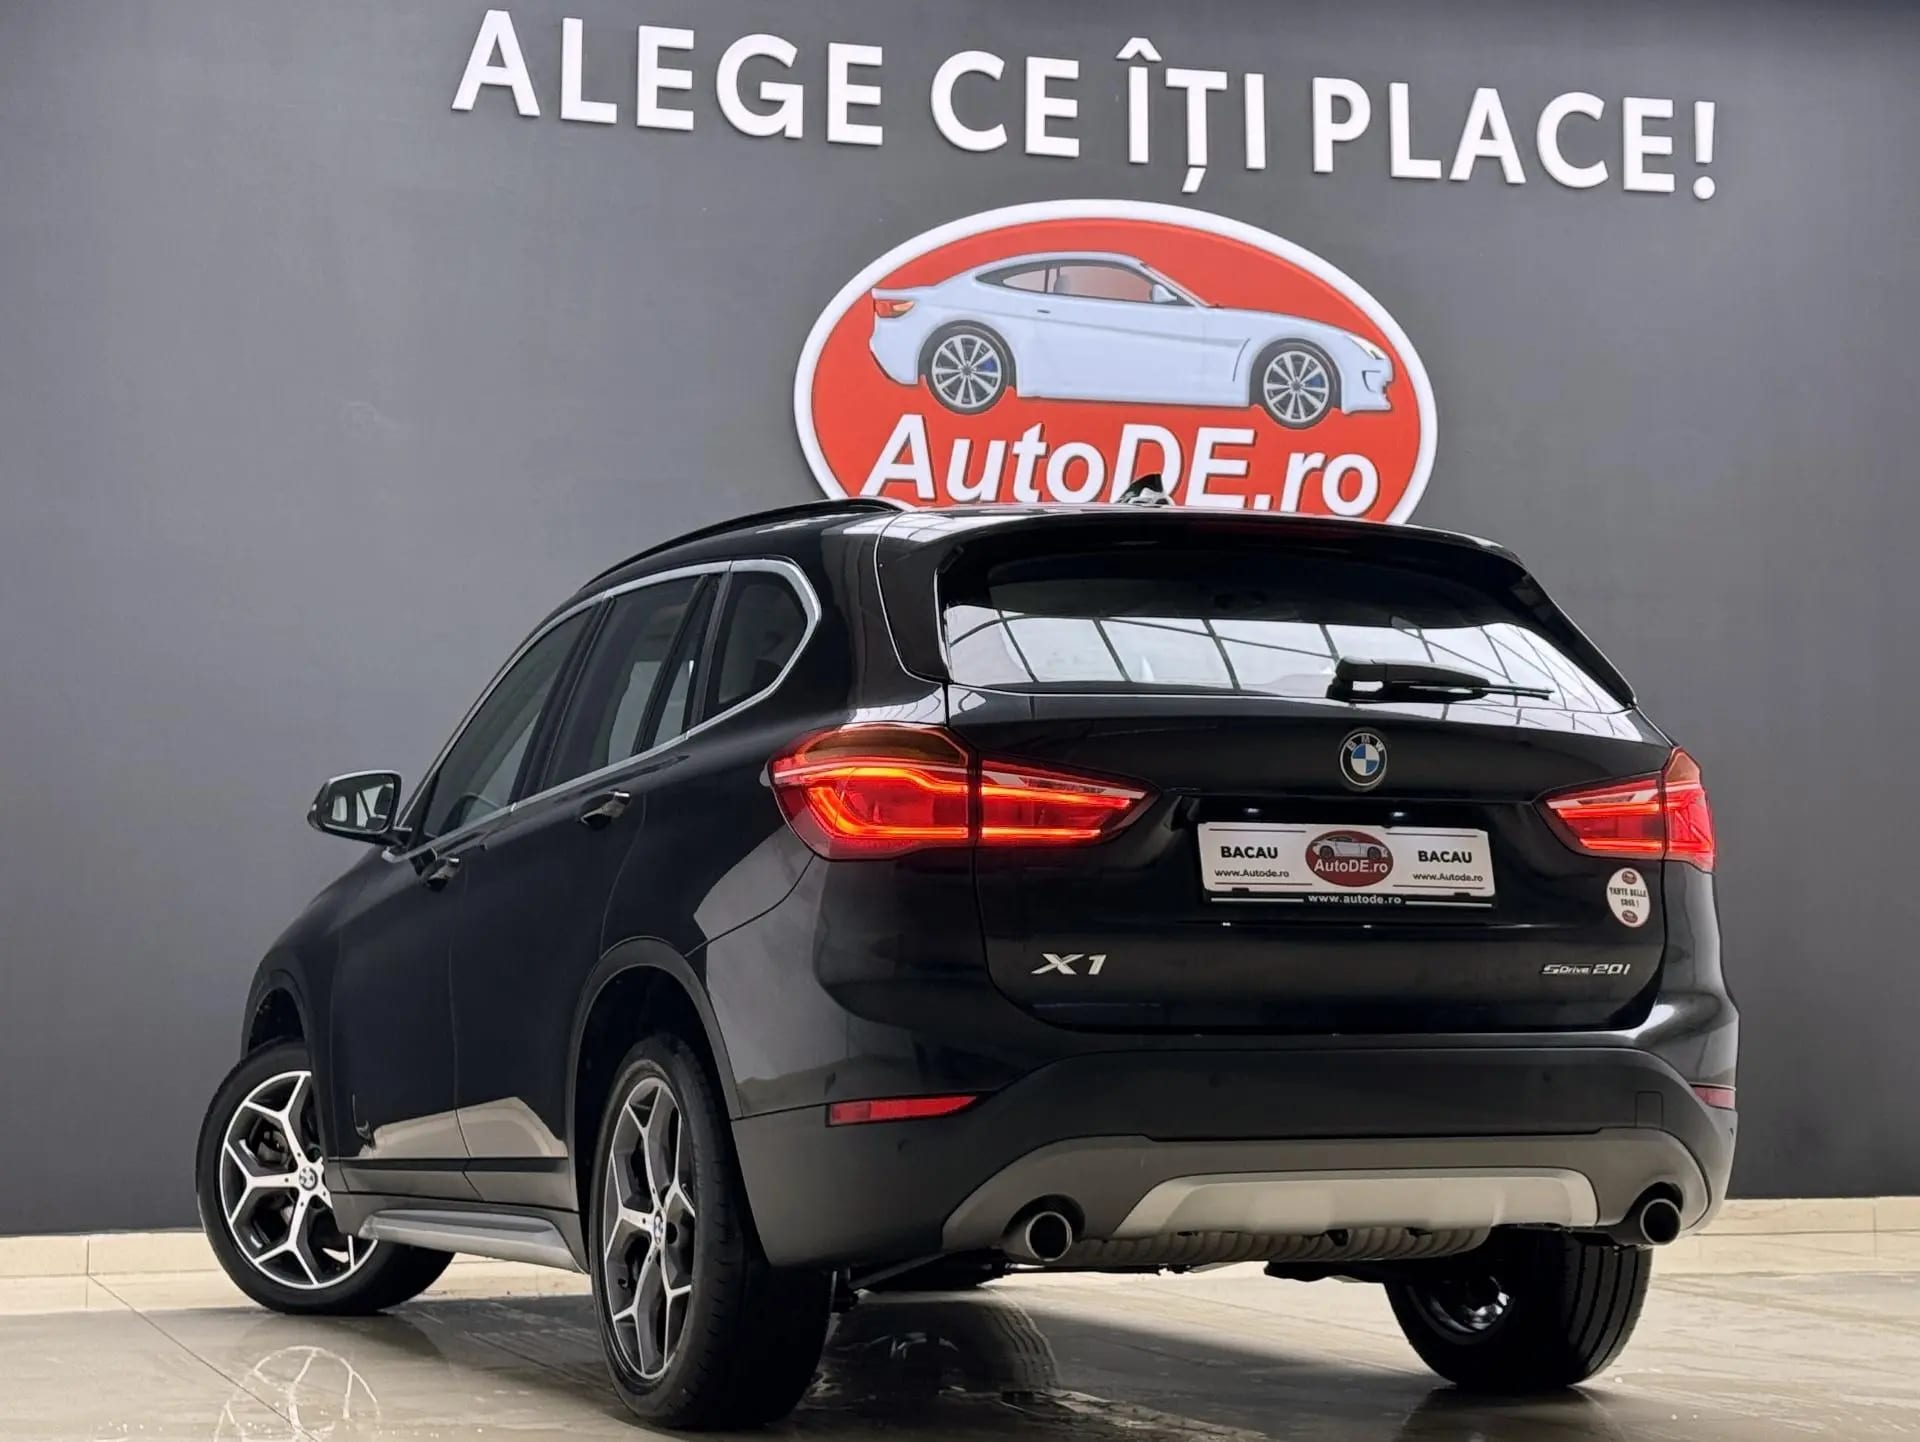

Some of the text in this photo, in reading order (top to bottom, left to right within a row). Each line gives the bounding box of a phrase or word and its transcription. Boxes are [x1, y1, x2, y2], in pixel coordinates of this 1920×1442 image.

[451, 8, 885, 147] ALEGE
[930, 50, 1081, 158] CE
[1311, 76, 1718, 201] PLACE!
[859, 412, 1380, 518] AutoDE.ro
[1220, 845, 1279, 860] BACAU
[1417, 849, 1473, 864] BACAU
[1313, 858, 1389, 874] AutoDE.ro
[1307, 893, 1402, 905] www.autode.ro
[1030, 953, 1107, 975] X1
